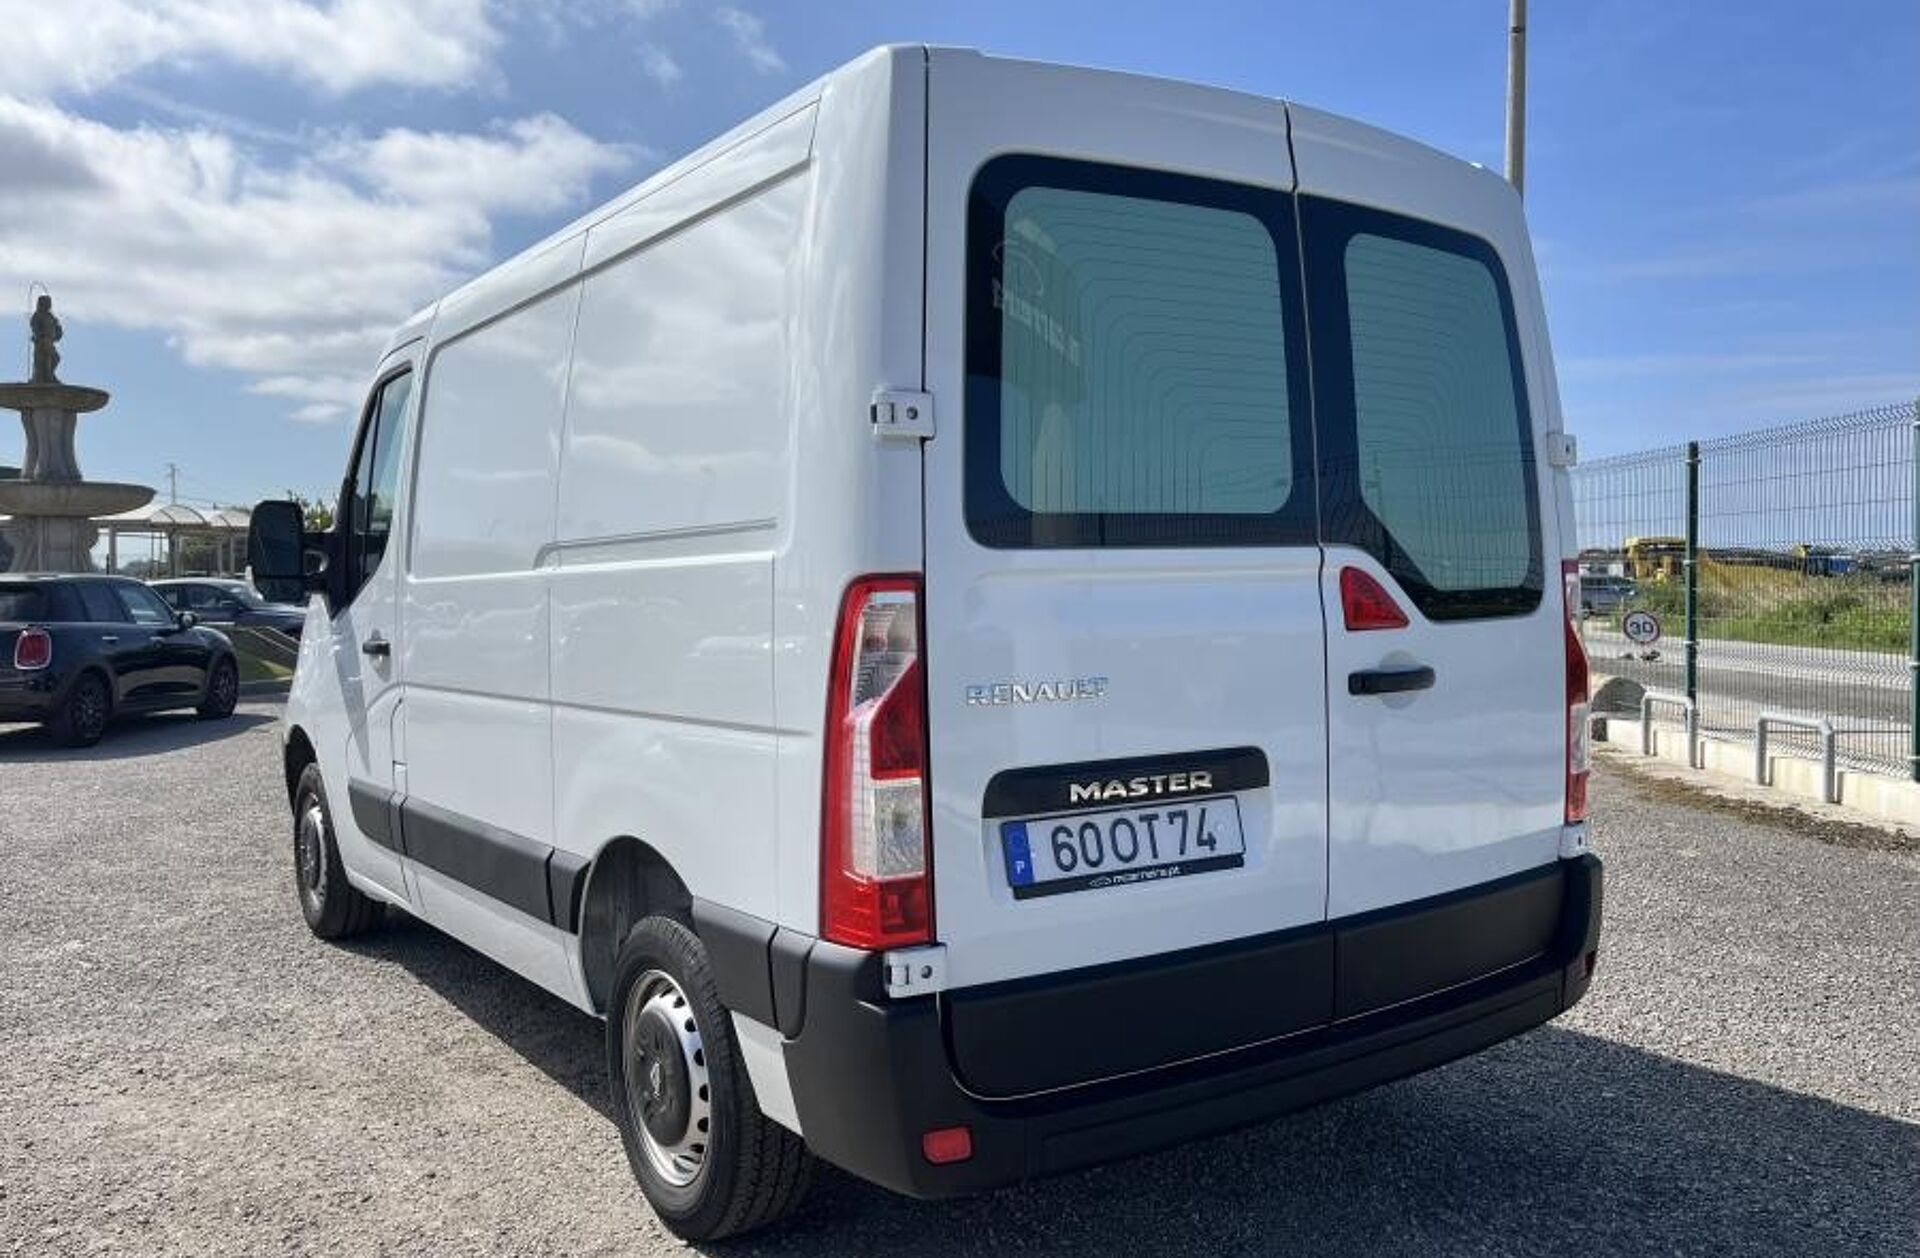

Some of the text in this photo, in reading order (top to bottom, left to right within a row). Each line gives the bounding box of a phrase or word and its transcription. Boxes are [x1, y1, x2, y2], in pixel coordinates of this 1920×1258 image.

[1629, 621, 1653, 635] 30
[966, 677, 1108, 706] RENAULT
[1069, 770, 1213, 803] MASTER
[1015, 860, 1025, 875] P
